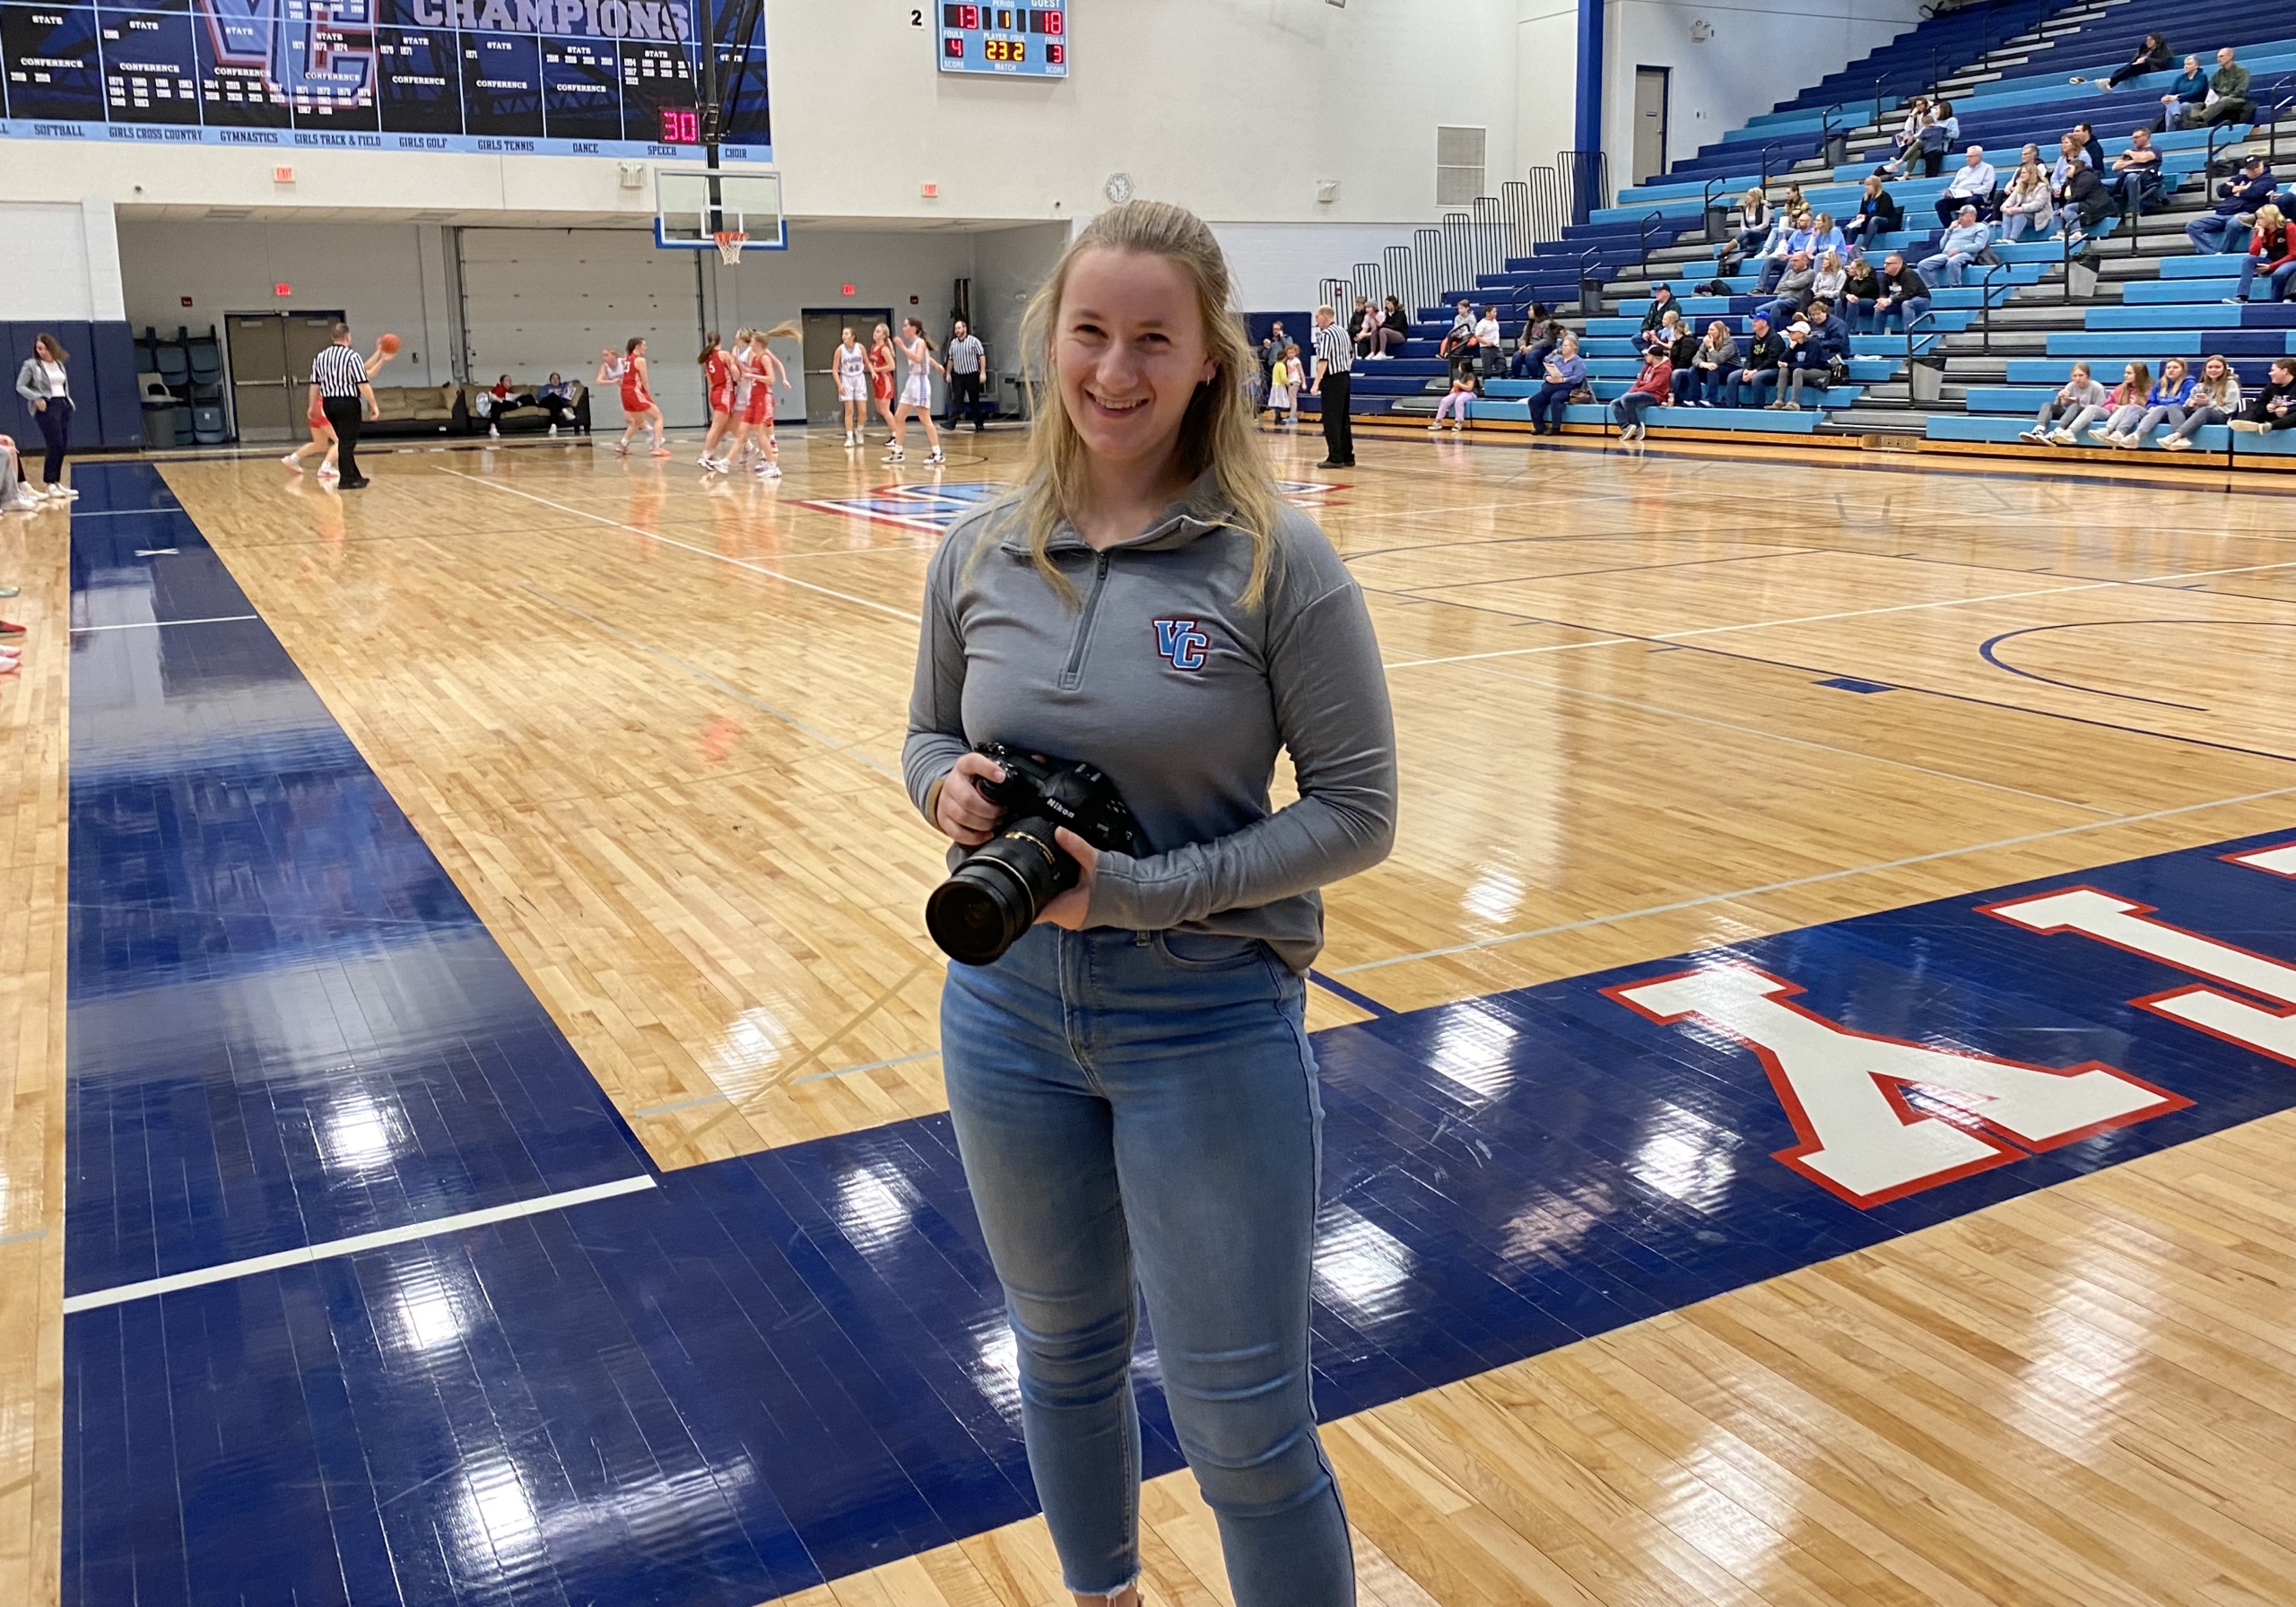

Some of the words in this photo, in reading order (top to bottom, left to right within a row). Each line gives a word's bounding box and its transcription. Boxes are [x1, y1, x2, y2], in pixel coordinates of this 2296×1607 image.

[992, 0, 1015, 8] PERIOD
[1031, 0, 1060, 8] GUEST
[32, 15, 63, 25] STATE
[413, 0, 690, 40] CHAMPIONS
[911, 10, 922, 26] 2
[960, 5, 978, 29] 13
[129, 21, 159, 30] STATE
[1045, 12, 1062, 34] 18
[225, 27, 254, 36] STATE
[316, 32, 344, 41] STATE
[944, 30, 964, 39] FOULS
[983, 32, 1008, 41] PLAYER
[403, 37, 429, 46] STATE
[486, 41, 512, 50] STATE
[334, 43, 348, 52] 1974
[400, 47, 413, 56] 1971
[567, 46, 591, 55] STATE
[952, 39, 962, 56] 4
[987, 41, 1008, 60] 23
[465, 49, 478, 59] 1971
[645, 50, 668, 58] STATE
[720, 54, 743, 63] STTE
[1053, 45, 1062, 63] 3
[21, 57, 83, 68] CONFERENCE
[944, 60, 965, 69] SCORE
[995, 64, 1017, 72] MATCH
[119, 63, 180, 74] CONFERENCE
[214, 67, 273, 78] CONFERENCE
[1045, 65, 1065, 74] SCORE
[305, 71, 361, 83] CONFERENCE
[392, 75, 446, 86] CONFERENCE
[475, 79, 528, 90] CONFERENCE
[556, 83, 606, 93] CONFERENCE
[34, 123, 85, 137] SOFTBALL
[664, 111, 696, 141] 30
[109, 126, 135, 139] GIRLS
[136, 128, 163, 141] CROSS
[164, 129, 203, 142] COUNTRY
[221, 130, 278, 144] GYMNASTICS
[294, 134, 318, 145] GIRLS
[320, 135, 346, 146] TRACK
[349, 135, 356, 146] &
[358, 135, 381, 147] FIELD
[399, 136, 424, 148] GIRLS
[426, 137, 448, 149] GOLF
[478, 139, 502, 151] GIRLS
[504, 140, 535, 152] TENNIS
[572, 142, 598, 154] DANCE
[648, 145, 677, 156] SPEECH
[725, 147, 747, 159] CHOIR
[708, 360, 716, 373] 5
[1152, 619, 1209, 671] VC
[1047, 797, 1075, 819] Nikon
